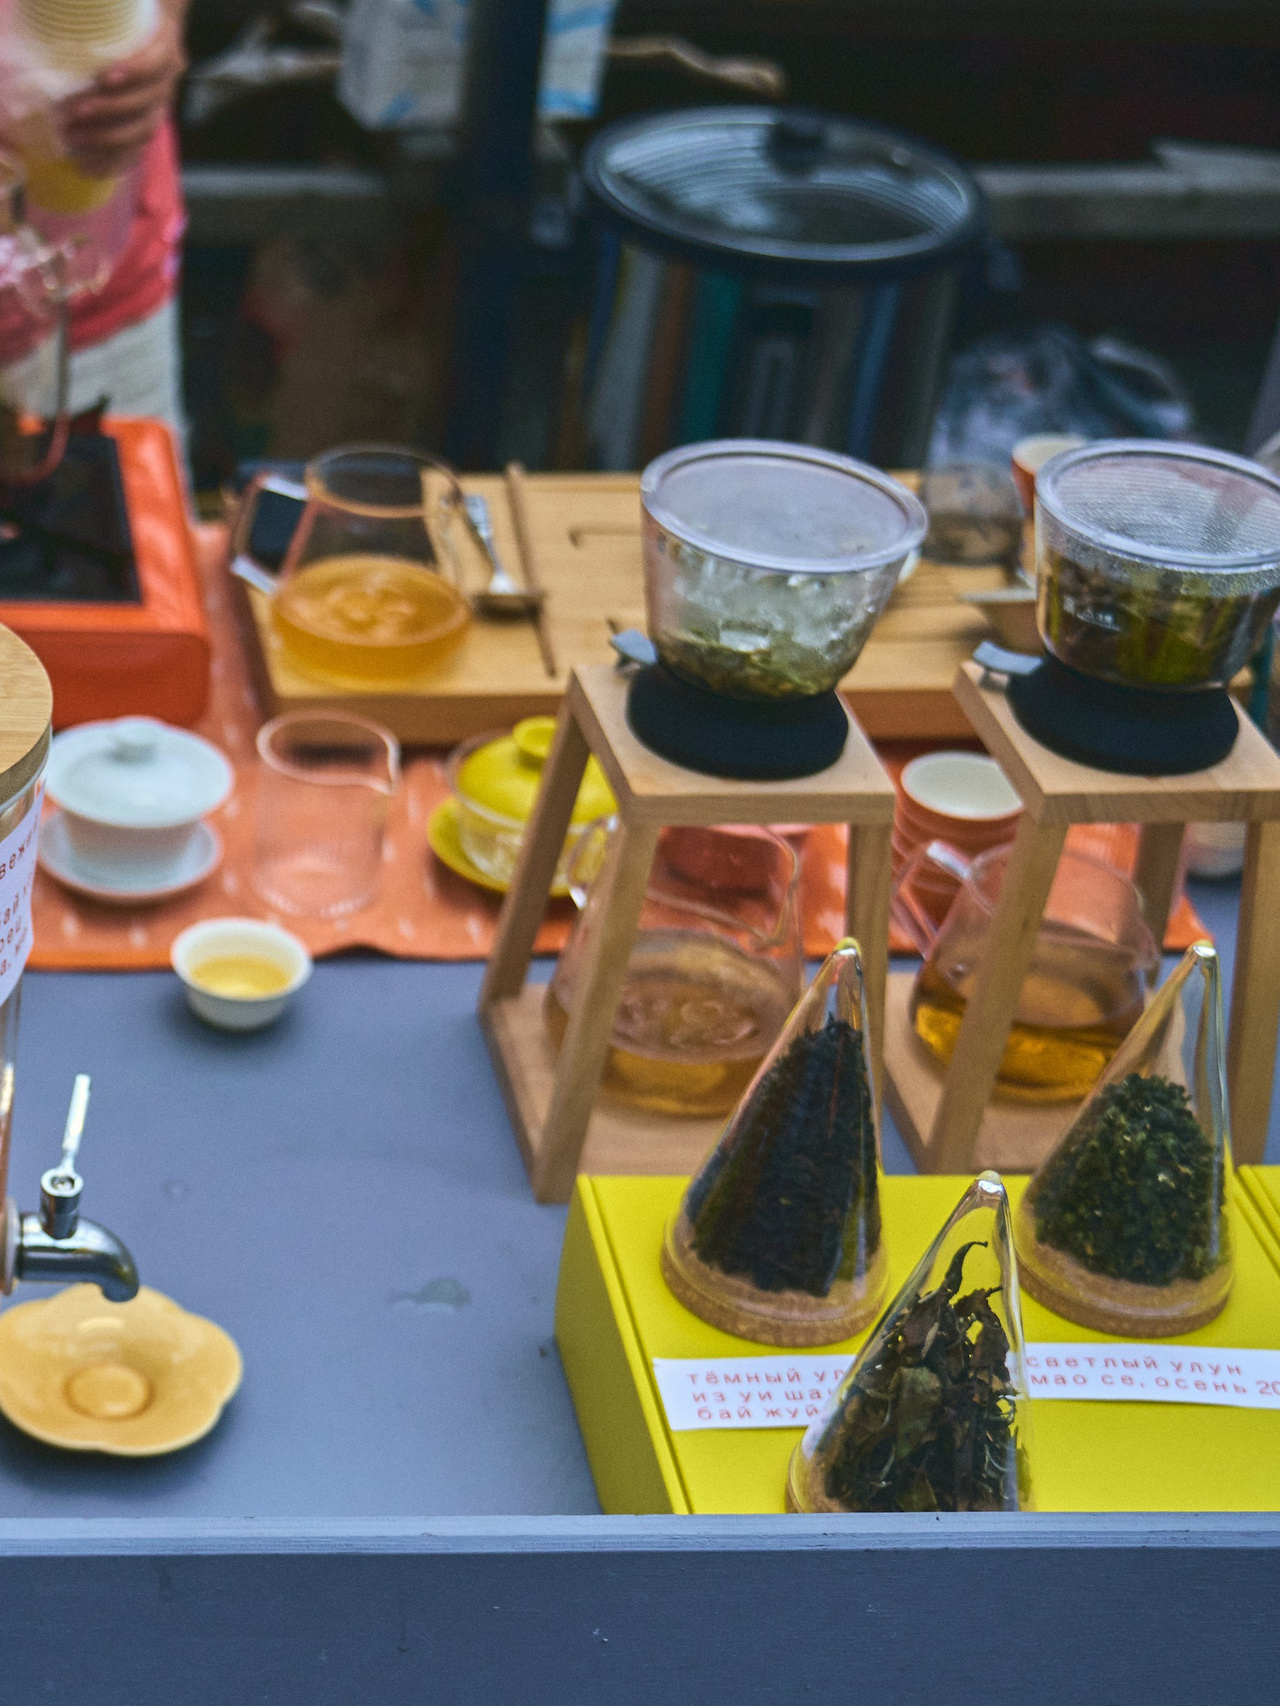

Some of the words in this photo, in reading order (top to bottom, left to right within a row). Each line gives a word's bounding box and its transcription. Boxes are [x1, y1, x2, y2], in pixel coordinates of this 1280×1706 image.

[1026, 1356, 1158, 1370] светлый
[1170, 1361, 1242, 1376] улун
[687, 1368, 801, 1385] тёмный
[813, 1368, 846, 1383] ул
[1030, 1373, 1087, 1386] мао
[1155, 1376, 1248, 1395] осень
[692, 1390, 726, 1404] из
[739, 1390, 773, 1404] уи
[784, 1388, 832, 1402] ша
[697, 1405, 753, 1420] бай
[765, 1403, 819, 1419] жуй
